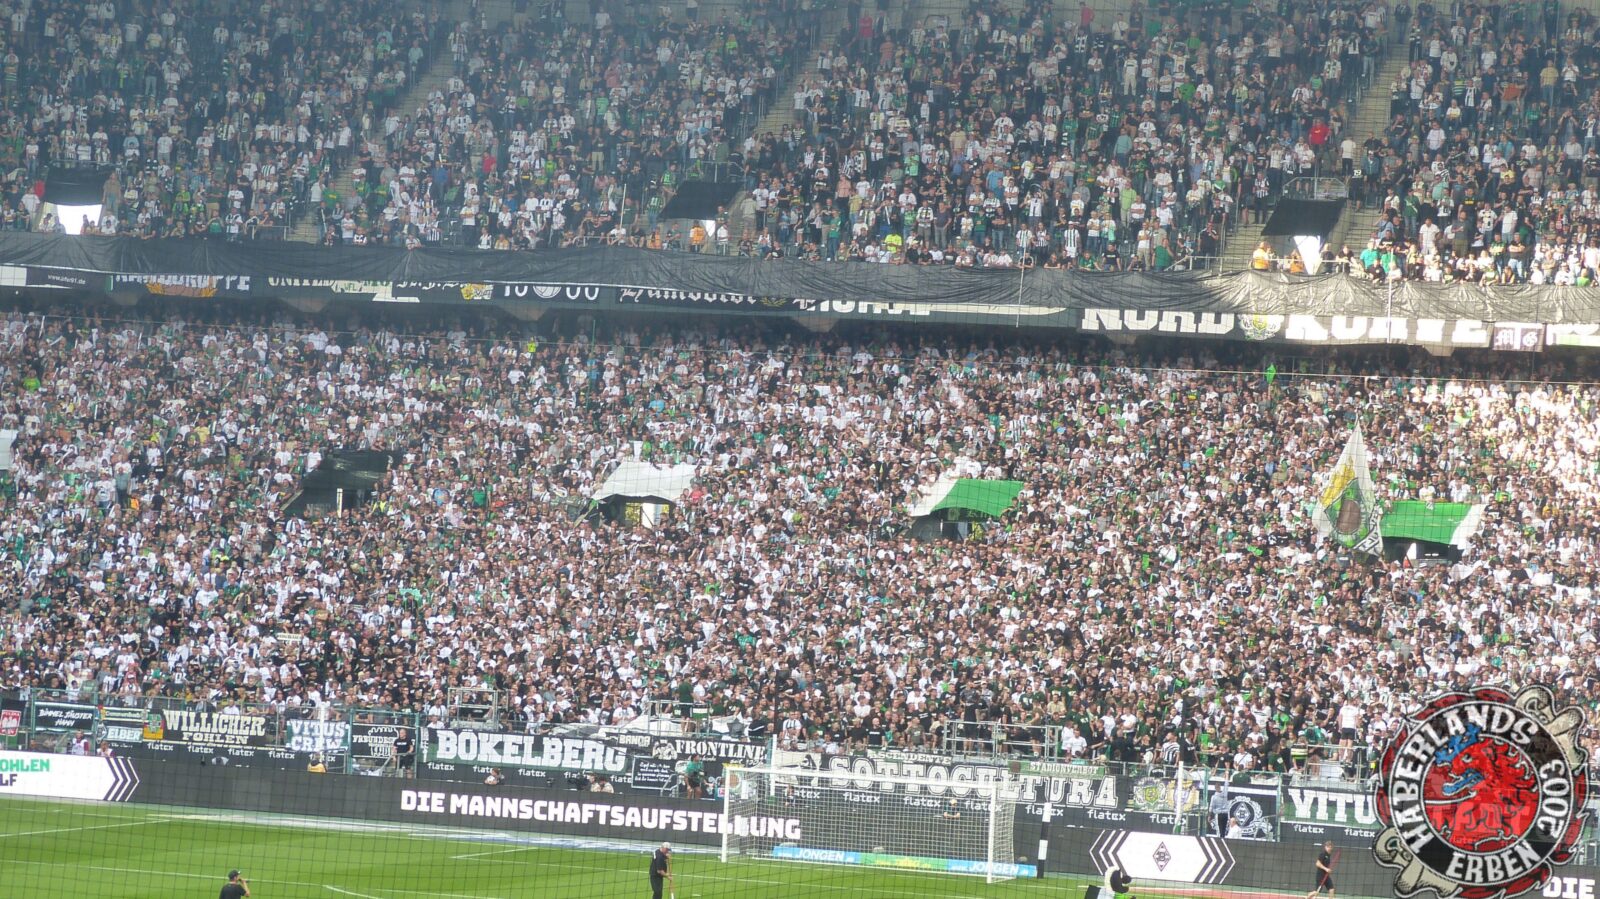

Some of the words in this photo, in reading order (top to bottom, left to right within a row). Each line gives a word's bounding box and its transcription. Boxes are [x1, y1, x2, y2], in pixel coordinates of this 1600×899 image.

[163, 709, 266, 737] WILLICHER
[290, 719, 346, 739] VITUS
[182, 732, 249, 745] FOHLEN
[147, 742, 174, 751] flatex
[187, 745, 214, 754] flatex
[228, 747, 255, 757] flatex
[436, 728, 628, 772] BÖKELBERG
[675, 739, 766, 761] FRONTLINE
[268, 750, 295, 760] flatex
[427, 762, 455, 771] flatex
[1030, 762, 1100, 776] STADIONVERBOT
[518, 768, 546, 778] flatex
[842, 791, 881, 804] flatex
[903, 796, 941, 808] flatex
[401, 790, 446, 814] DIE
[450, 793, 801, 840] MANNSCHAFTSAUFSTELLUNG
[1087, 809, 1126, 821] flatex
[1292, 823, 1325, 834] flatex
[1344, 828, 1376, 838] flatex
[1542, 876, 1596, 899] DIE
